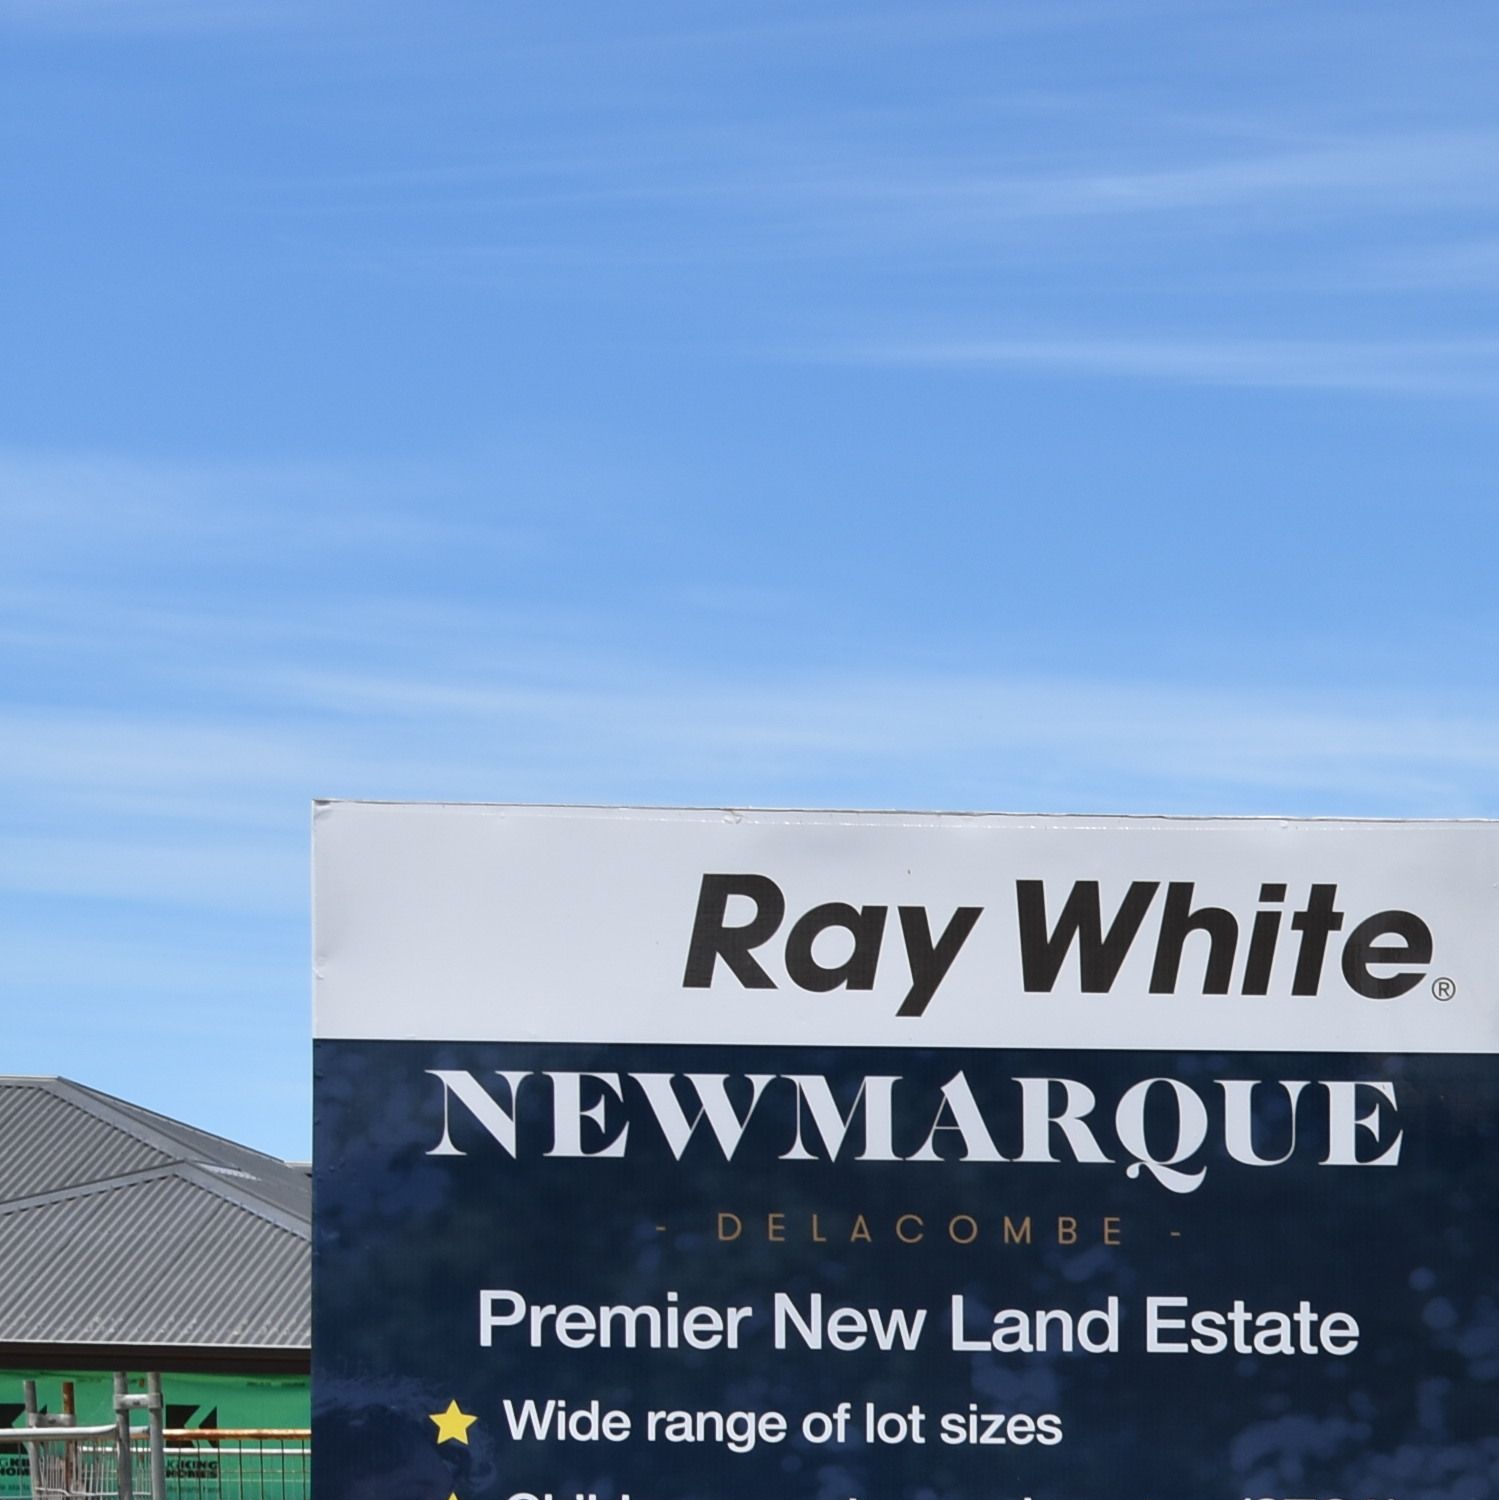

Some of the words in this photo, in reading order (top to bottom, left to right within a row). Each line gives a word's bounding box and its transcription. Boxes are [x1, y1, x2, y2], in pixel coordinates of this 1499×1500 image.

[683, 874, 983, 1016] Ray
[1016, 880, 1434, 999] White
[426, 1070, 1402, 1193] NEWMARQUE
[717, 1213, 1121, 1245] DELACOMBE
[480, 1290, 752, 1349] Premier
[775, 1293, 926, 1350] New
[952, 1295, 1118, 1353] Land
[1147, 1297, 1359, 1355] Estate
[503, 1400, 631, 1441] Wide
[648, 1411, 786, 1452] range
[803, 1403, 851, 1443] of
[867, 1403, 925, 1443] lot
[941, 1404, 1062, 1445] sizes
